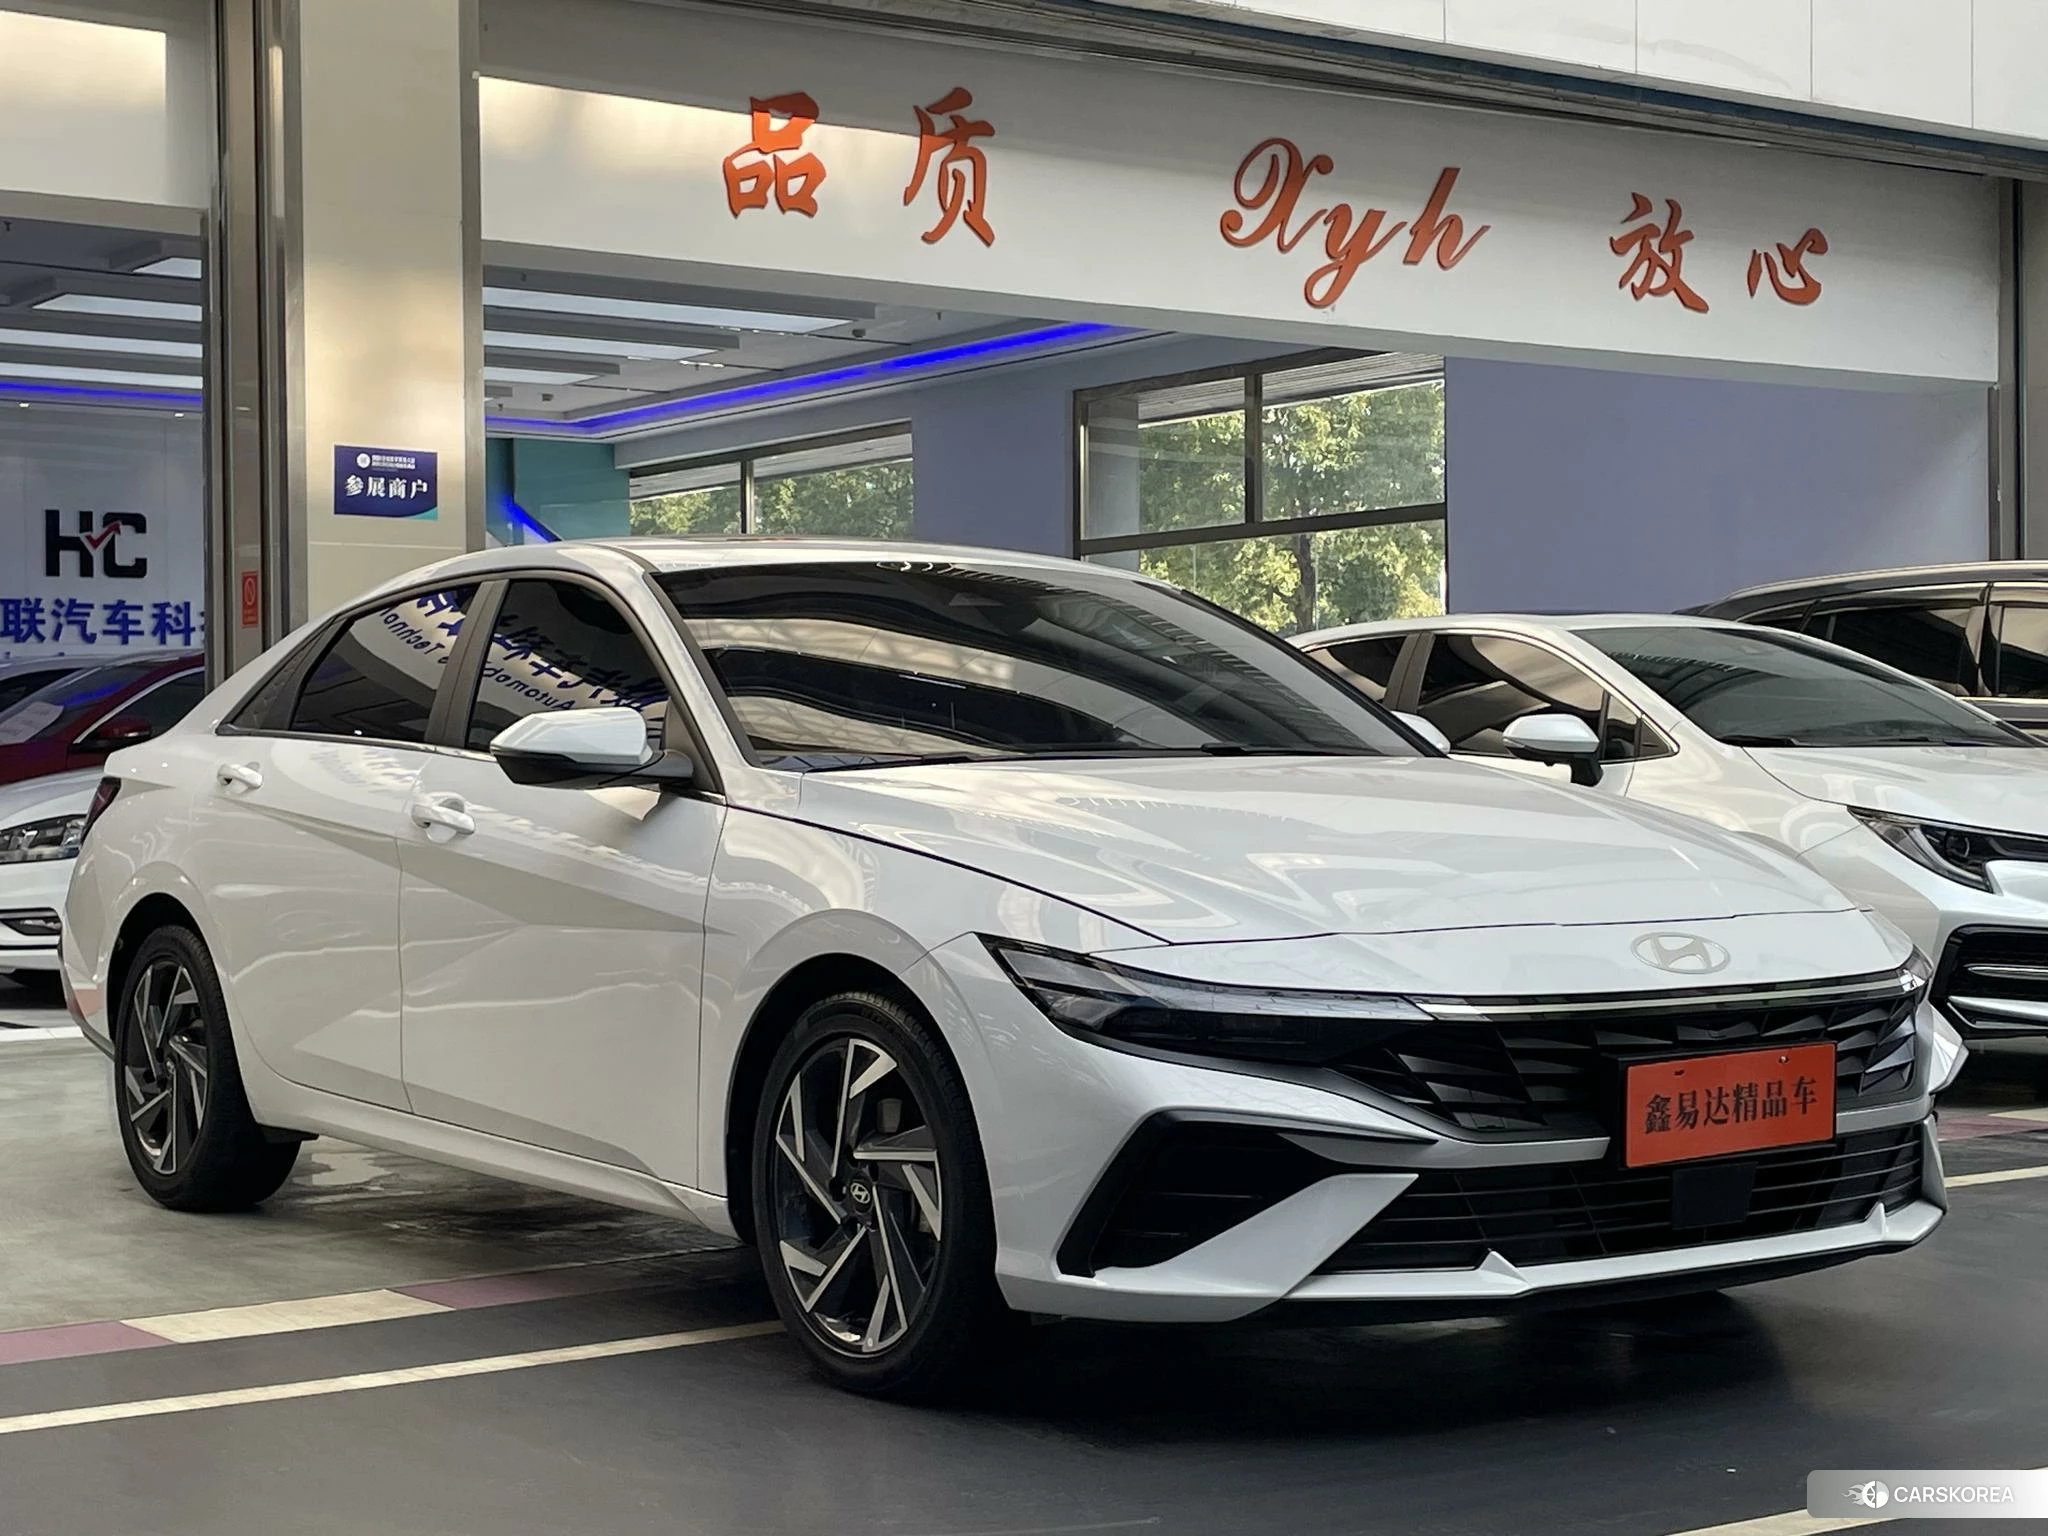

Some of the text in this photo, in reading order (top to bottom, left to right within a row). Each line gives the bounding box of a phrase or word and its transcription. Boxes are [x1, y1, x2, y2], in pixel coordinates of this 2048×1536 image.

[722, 86, 996, 248] 品质
[1608, 191, 1829, 314] 放心
[345, 474, 429, 500] 参展商户
[0, 598, 205, 646] 联汽车科
[1645, 1076, 1817, 1134] 鑫易达精品车
